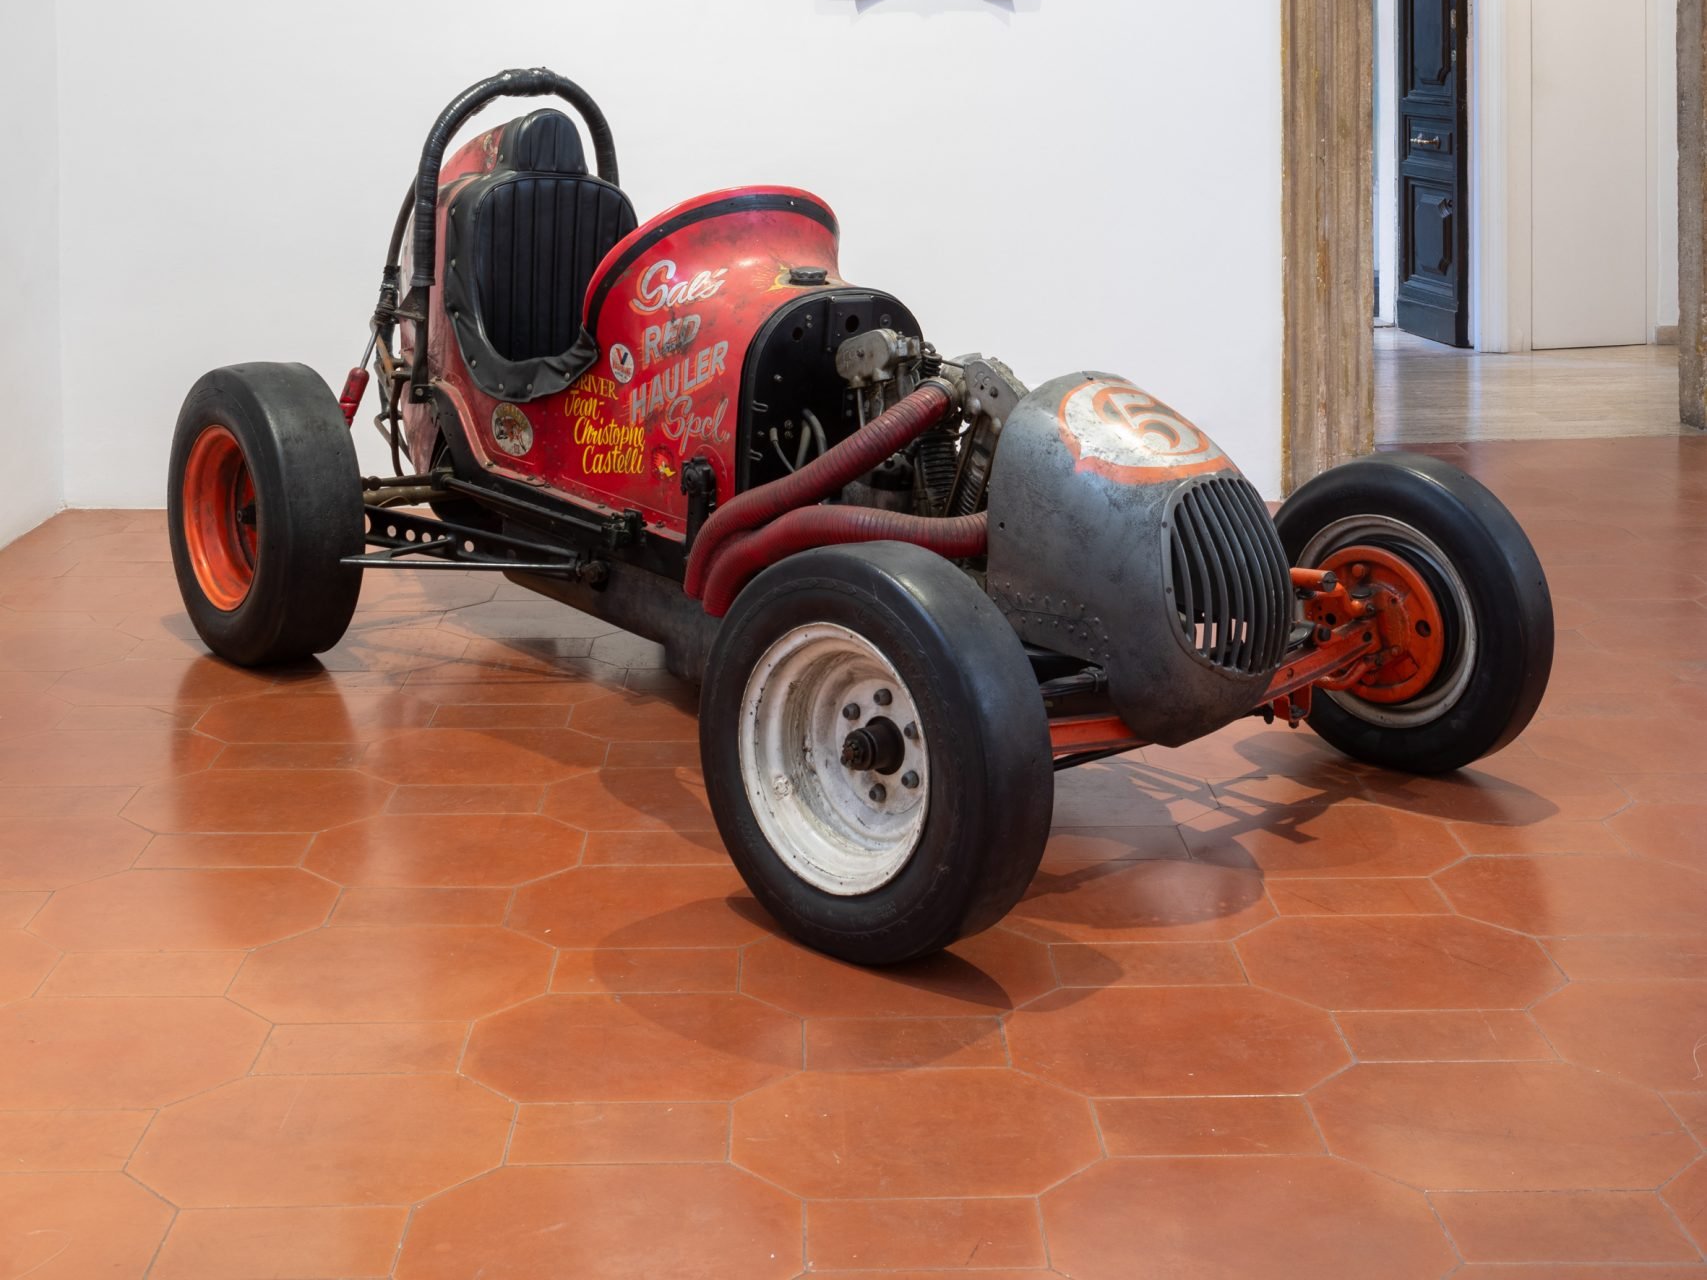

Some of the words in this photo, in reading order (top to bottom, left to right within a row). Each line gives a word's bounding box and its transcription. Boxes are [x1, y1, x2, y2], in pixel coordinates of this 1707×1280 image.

[630, 259, 728, 314] Sal's
[642, 314, 701, 367] RED
[631, 340, 729, 425] HAULER
[583, 445, 645, 475] Castelli
